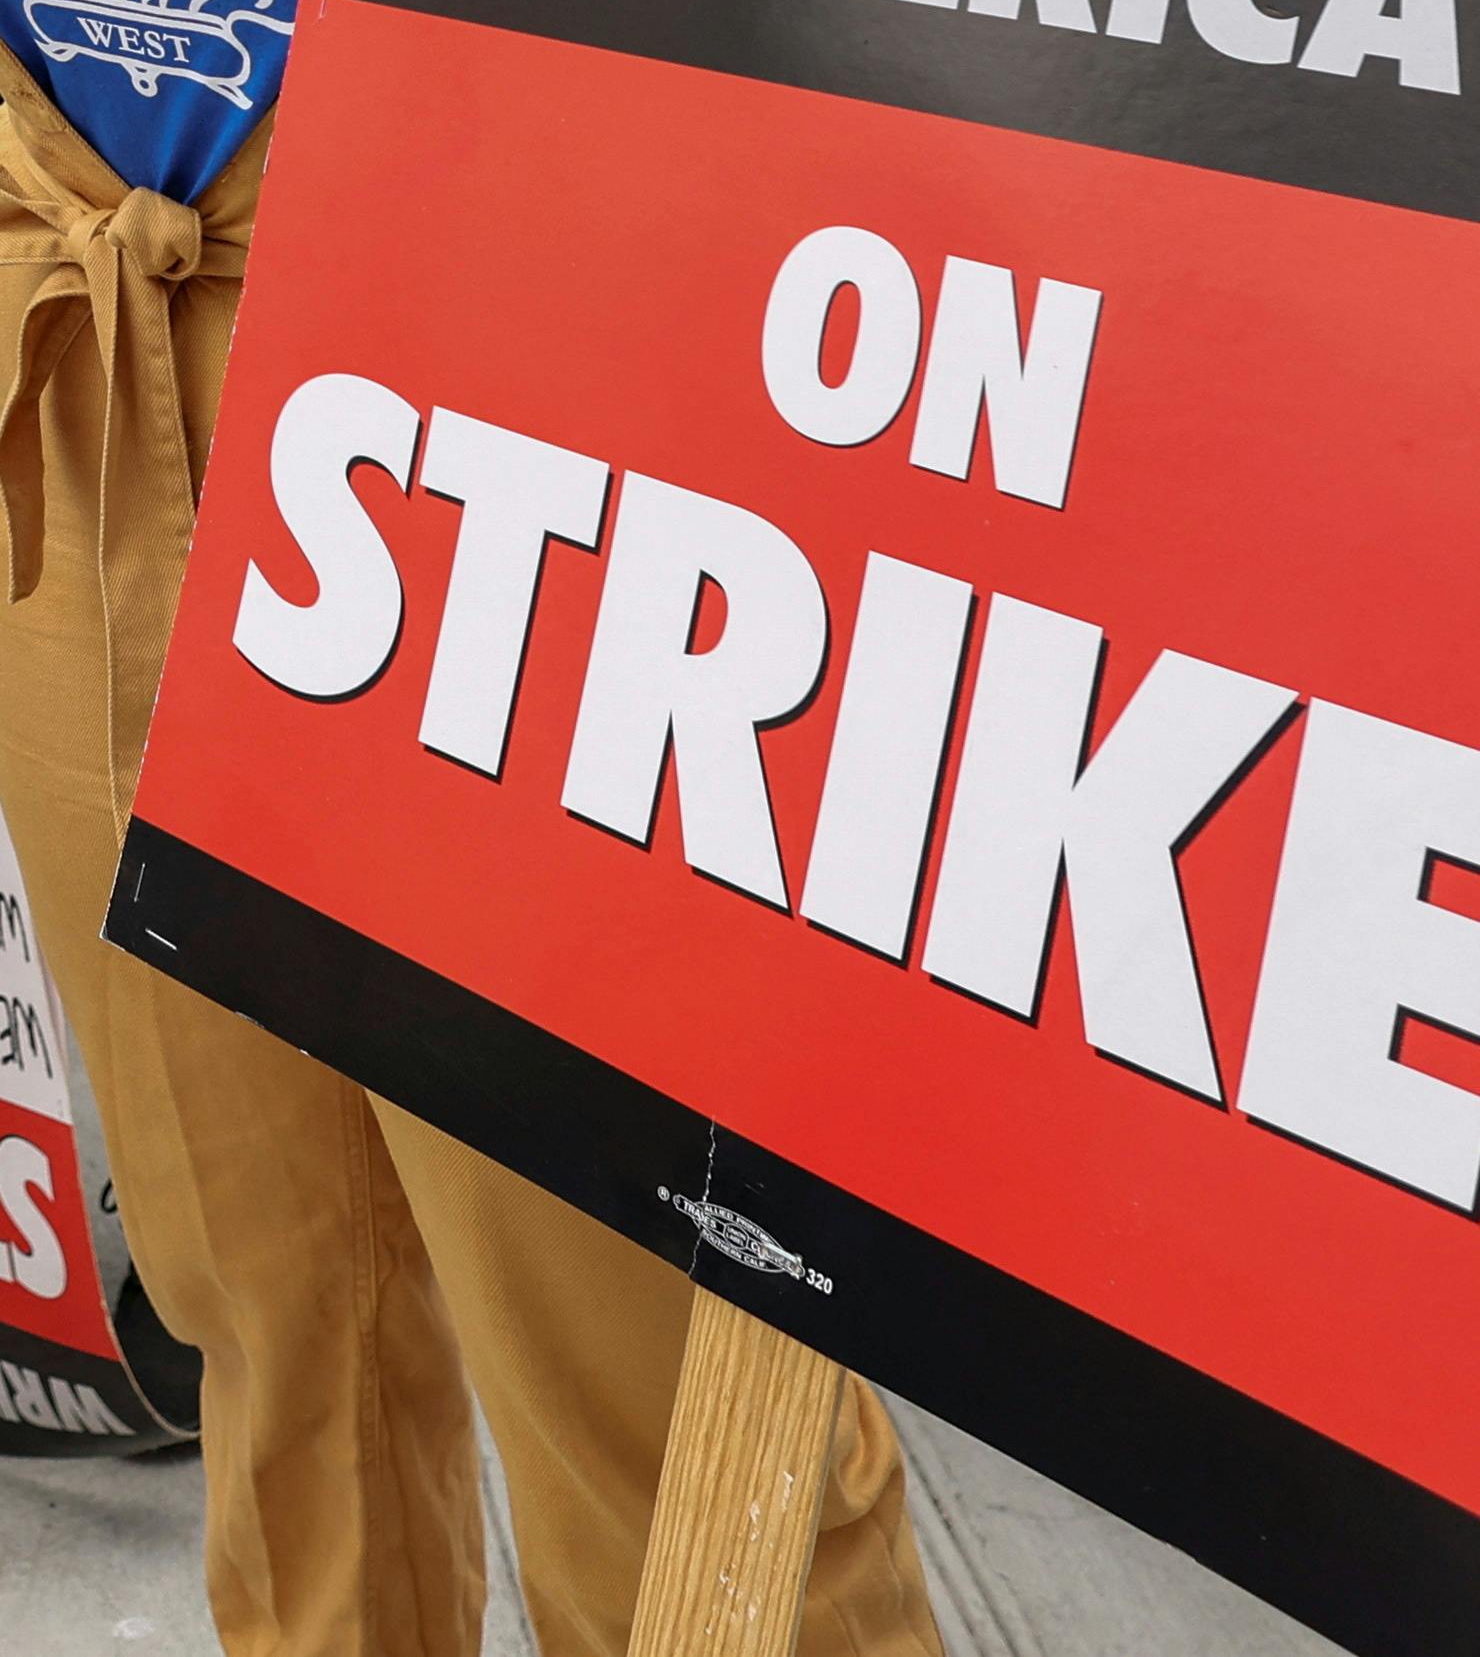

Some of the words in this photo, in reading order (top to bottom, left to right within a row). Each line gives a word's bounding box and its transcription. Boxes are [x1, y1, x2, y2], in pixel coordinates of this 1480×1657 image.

[77, 15, 192, 64] WEST
[760, 223, 1105, 514] ON
[230, 369, 1480, 1216] STRIKE
[805, 1267, 834, 1297] 320
